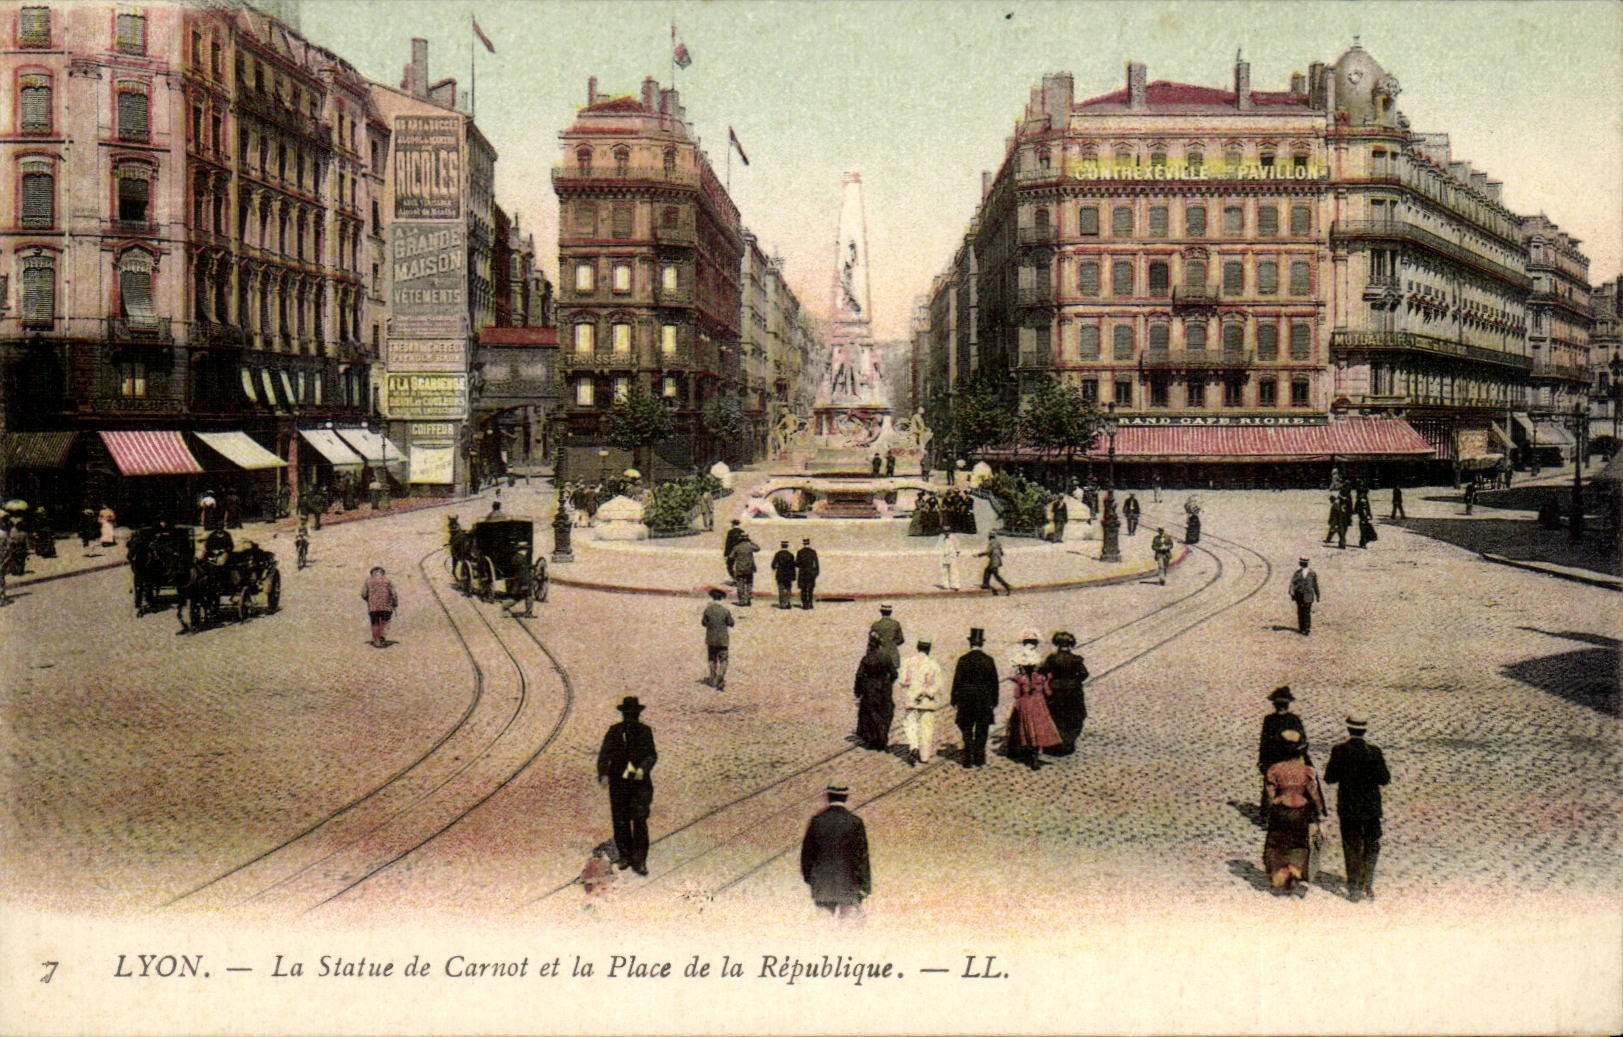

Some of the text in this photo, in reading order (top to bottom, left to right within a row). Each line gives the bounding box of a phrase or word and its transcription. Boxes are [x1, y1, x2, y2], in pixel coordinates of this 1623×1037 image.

[1237, 165, 1319, 180] PAVILLON
[394, 230, 461, 258] GRANDE
[394, 252, 462, 280] MAISON
[1334, 333, 1382, 346] MUTUAL
[1118, 417, 1171, 426] RAND
[1239, 417, 1305, 426] RICHE
[411, 423, 455, 435] COIFFEUR
